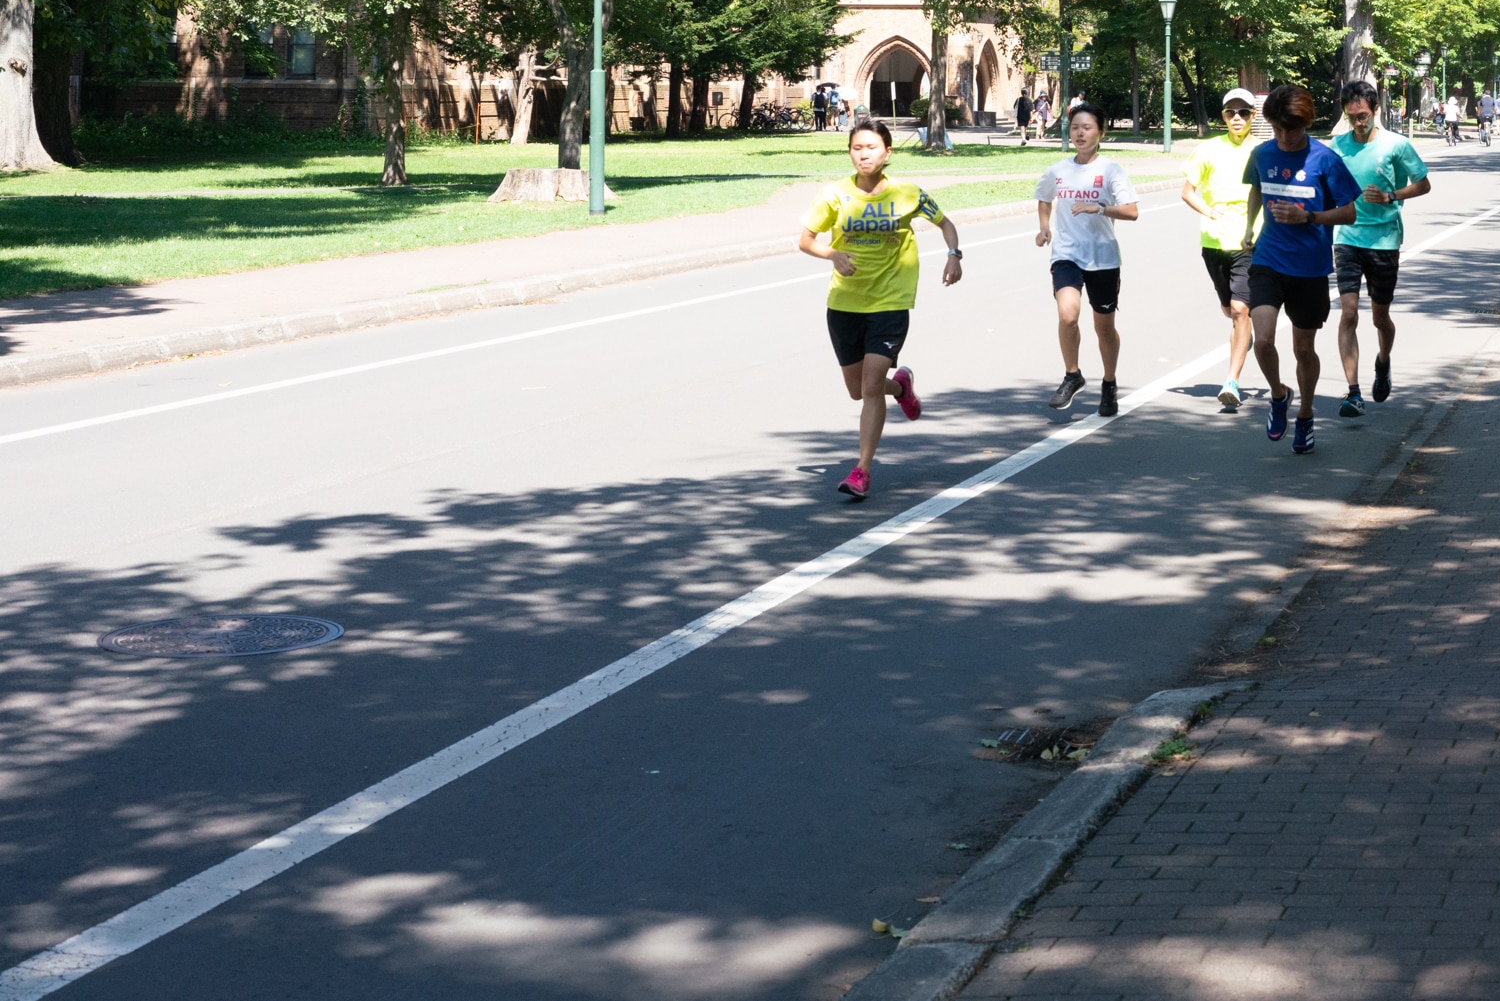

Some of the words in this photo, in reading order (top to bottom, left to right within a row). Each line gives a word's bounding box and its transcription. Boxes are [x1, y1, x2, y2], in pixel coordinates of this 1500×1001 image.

[1057, 190, 1099, 199] KITANO
[862, 201, 902, 218] ALL
[842, 216, 901, 233] Japan
